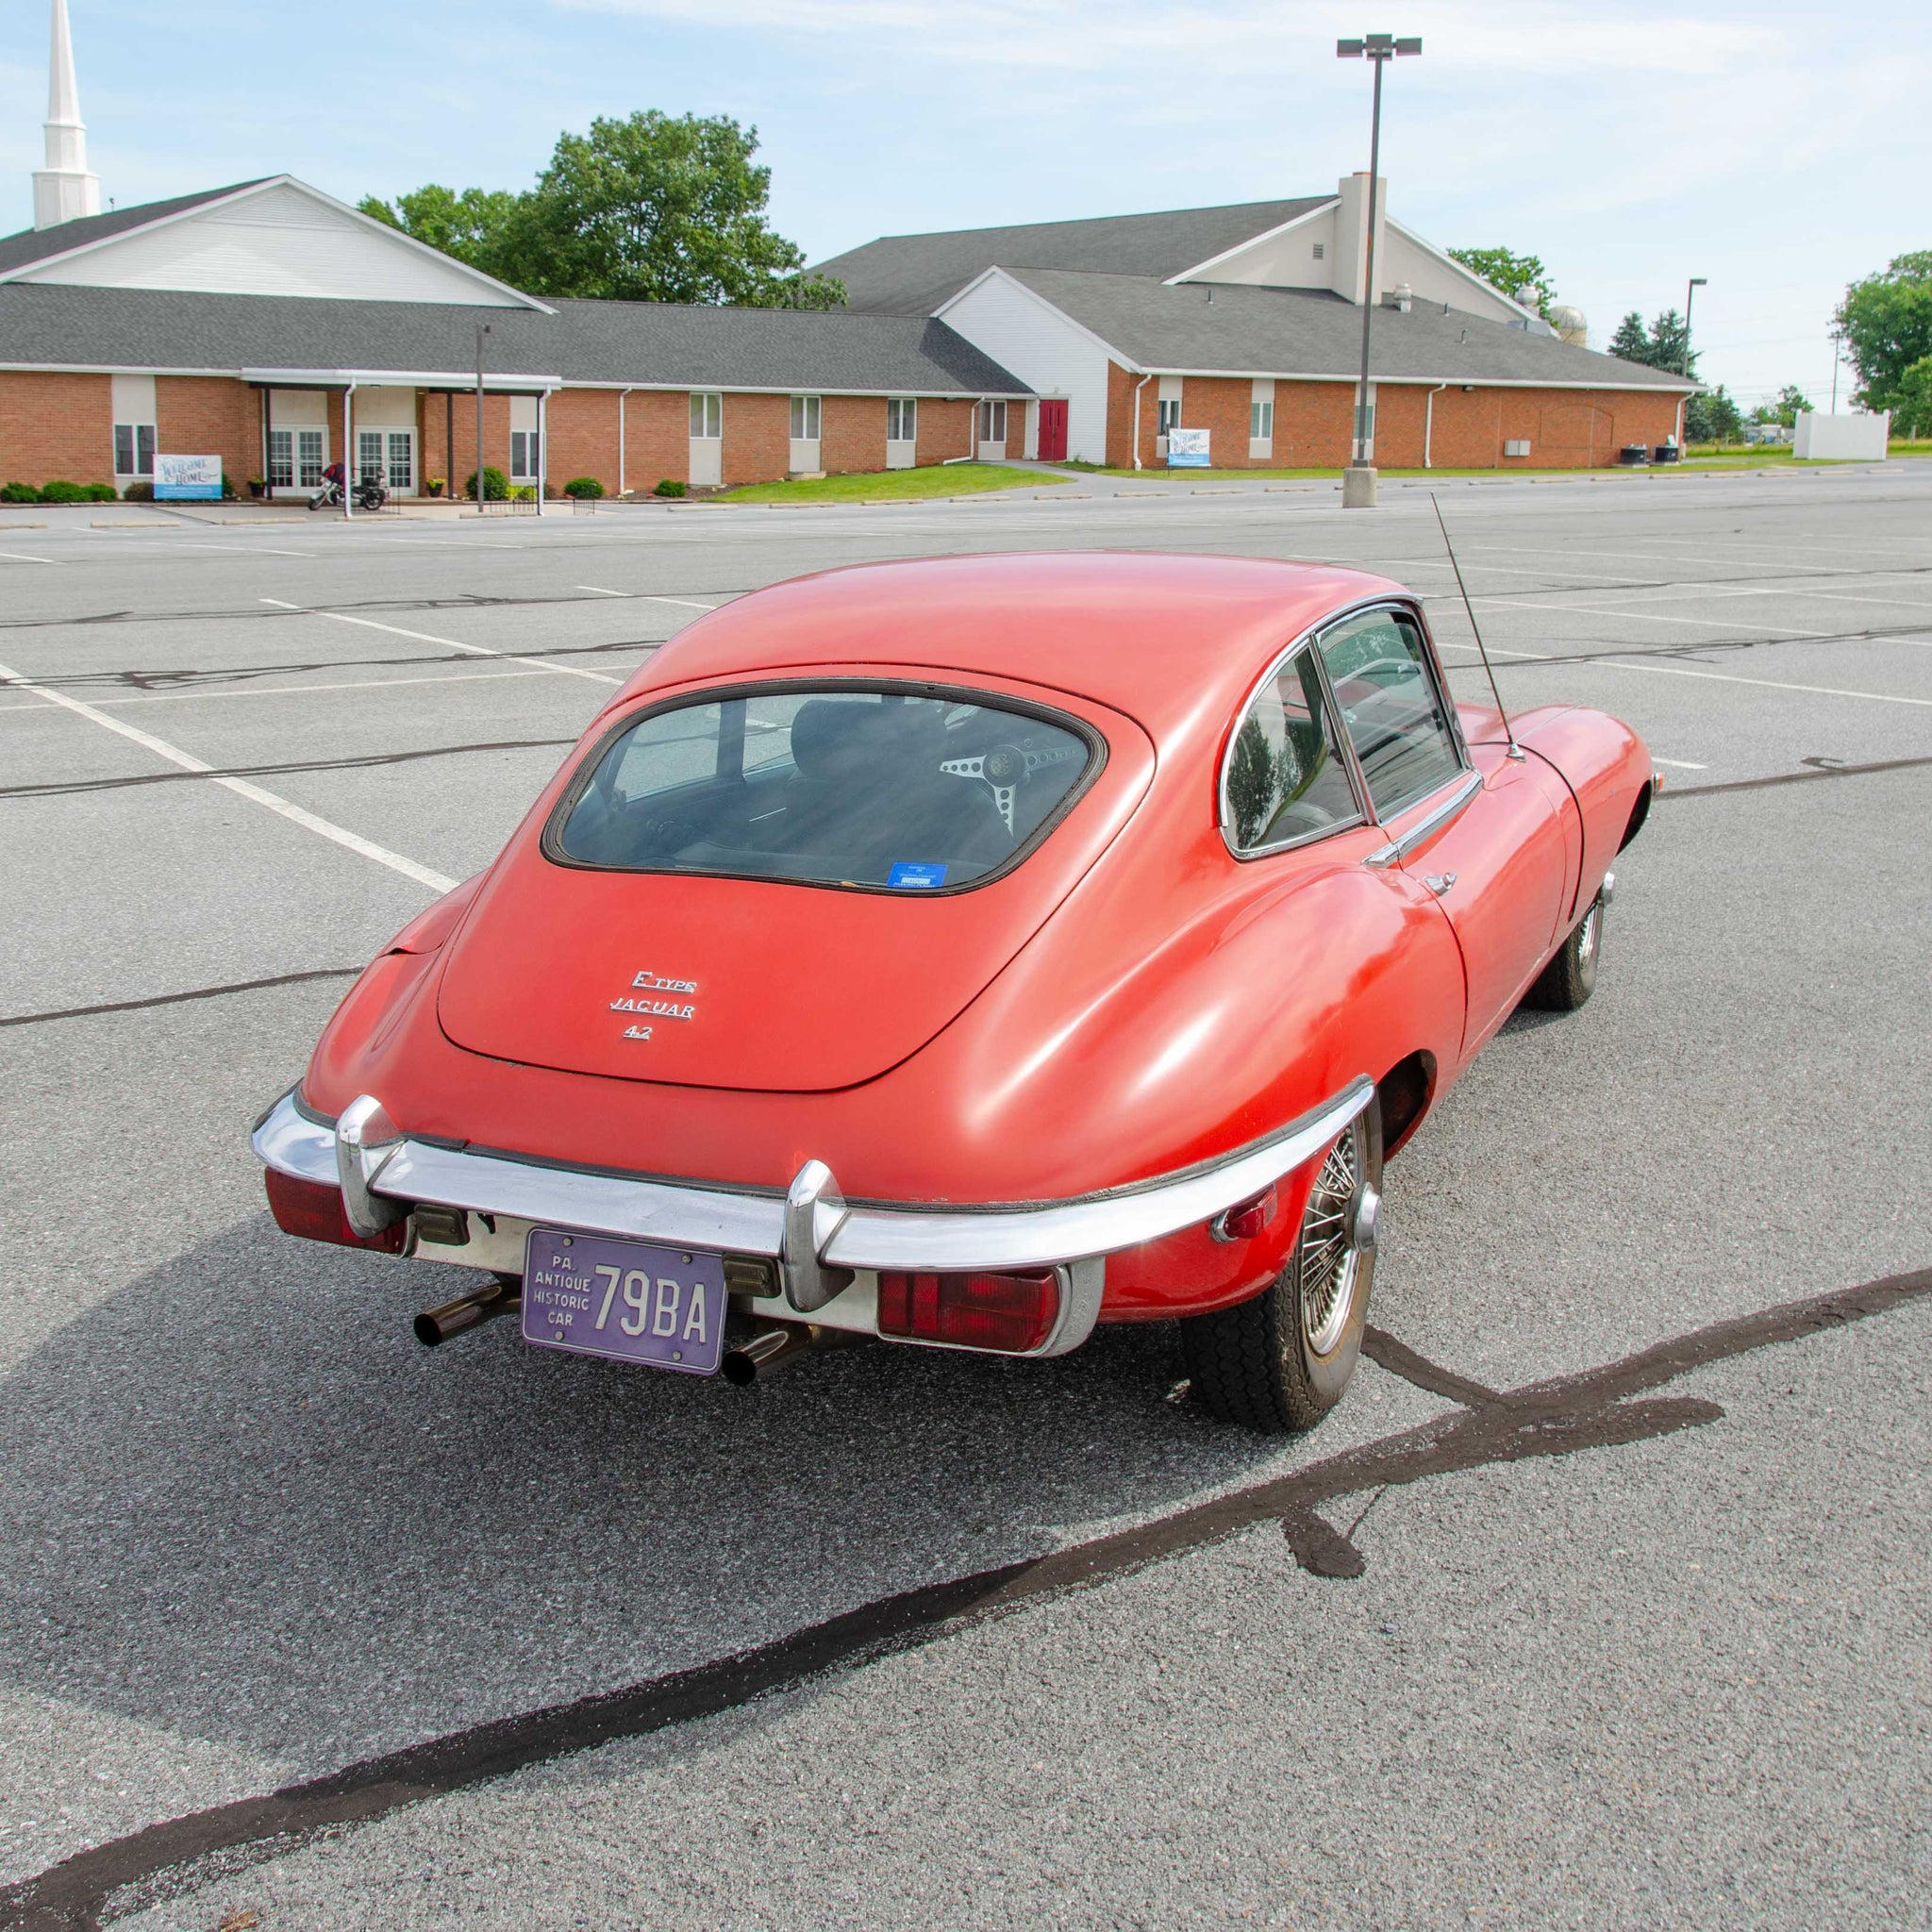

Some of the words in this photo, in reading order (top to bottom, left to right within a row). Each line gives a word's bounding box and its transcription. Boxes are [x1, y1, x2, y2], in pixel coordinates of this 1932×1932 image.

[175, 471, 207, 487] HOME
[609, 997, 694, 1019] JAGUAR
[535, 1271, 591, 1292] ANTIQUE
[533, 1290, 590, 1311] HISTORIC
[594, 1264, 707, 1343] 79BA
[547, 1310, 573, 1326] CAR
